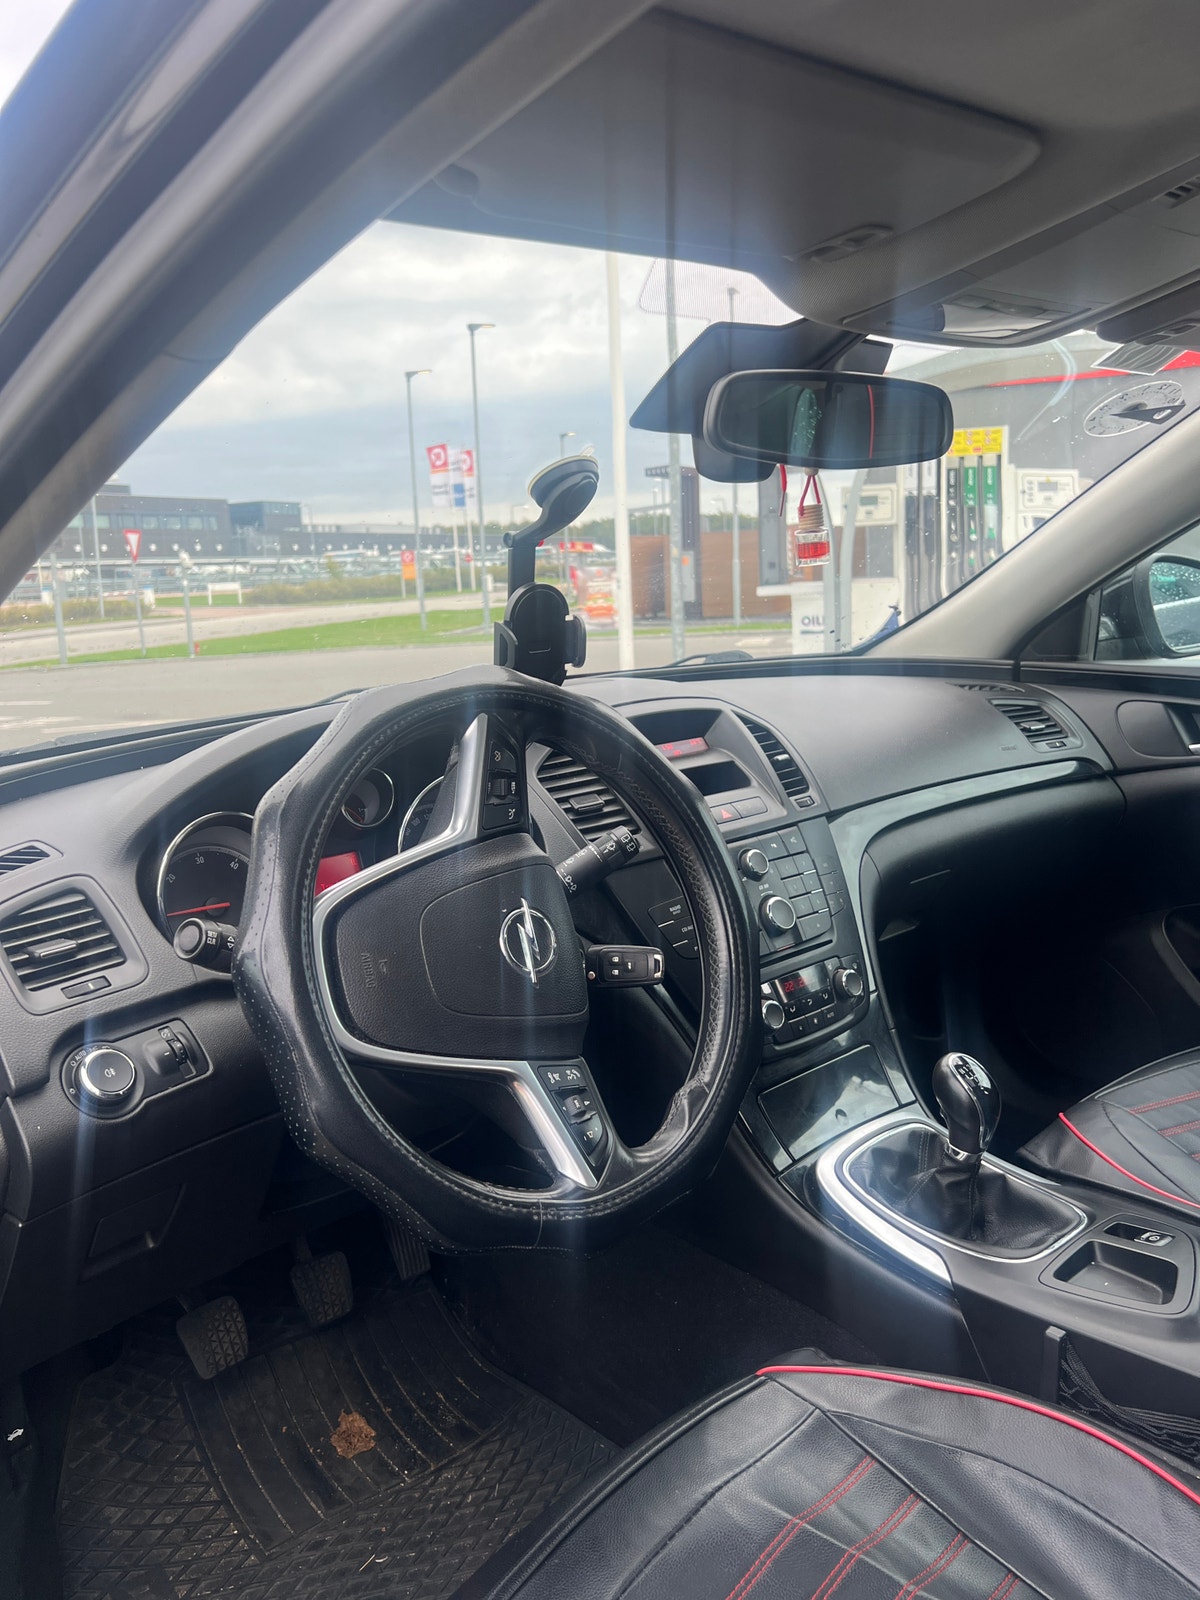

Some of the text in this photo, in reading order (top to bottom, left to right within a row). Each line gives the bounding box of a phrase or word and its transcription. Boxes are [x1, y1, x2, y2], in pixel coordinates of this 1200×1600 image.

[801, 614, 822, 627] OIL
[194, 856, 205, 865] 30
[229, 861, 239, 870] 40
[166, 873, 176, 883] 20
[360, 953, 376, 988] AIRBAG
[784, 980, 795, 993] 22
[75, 1050, 87, 1062] AUTO
